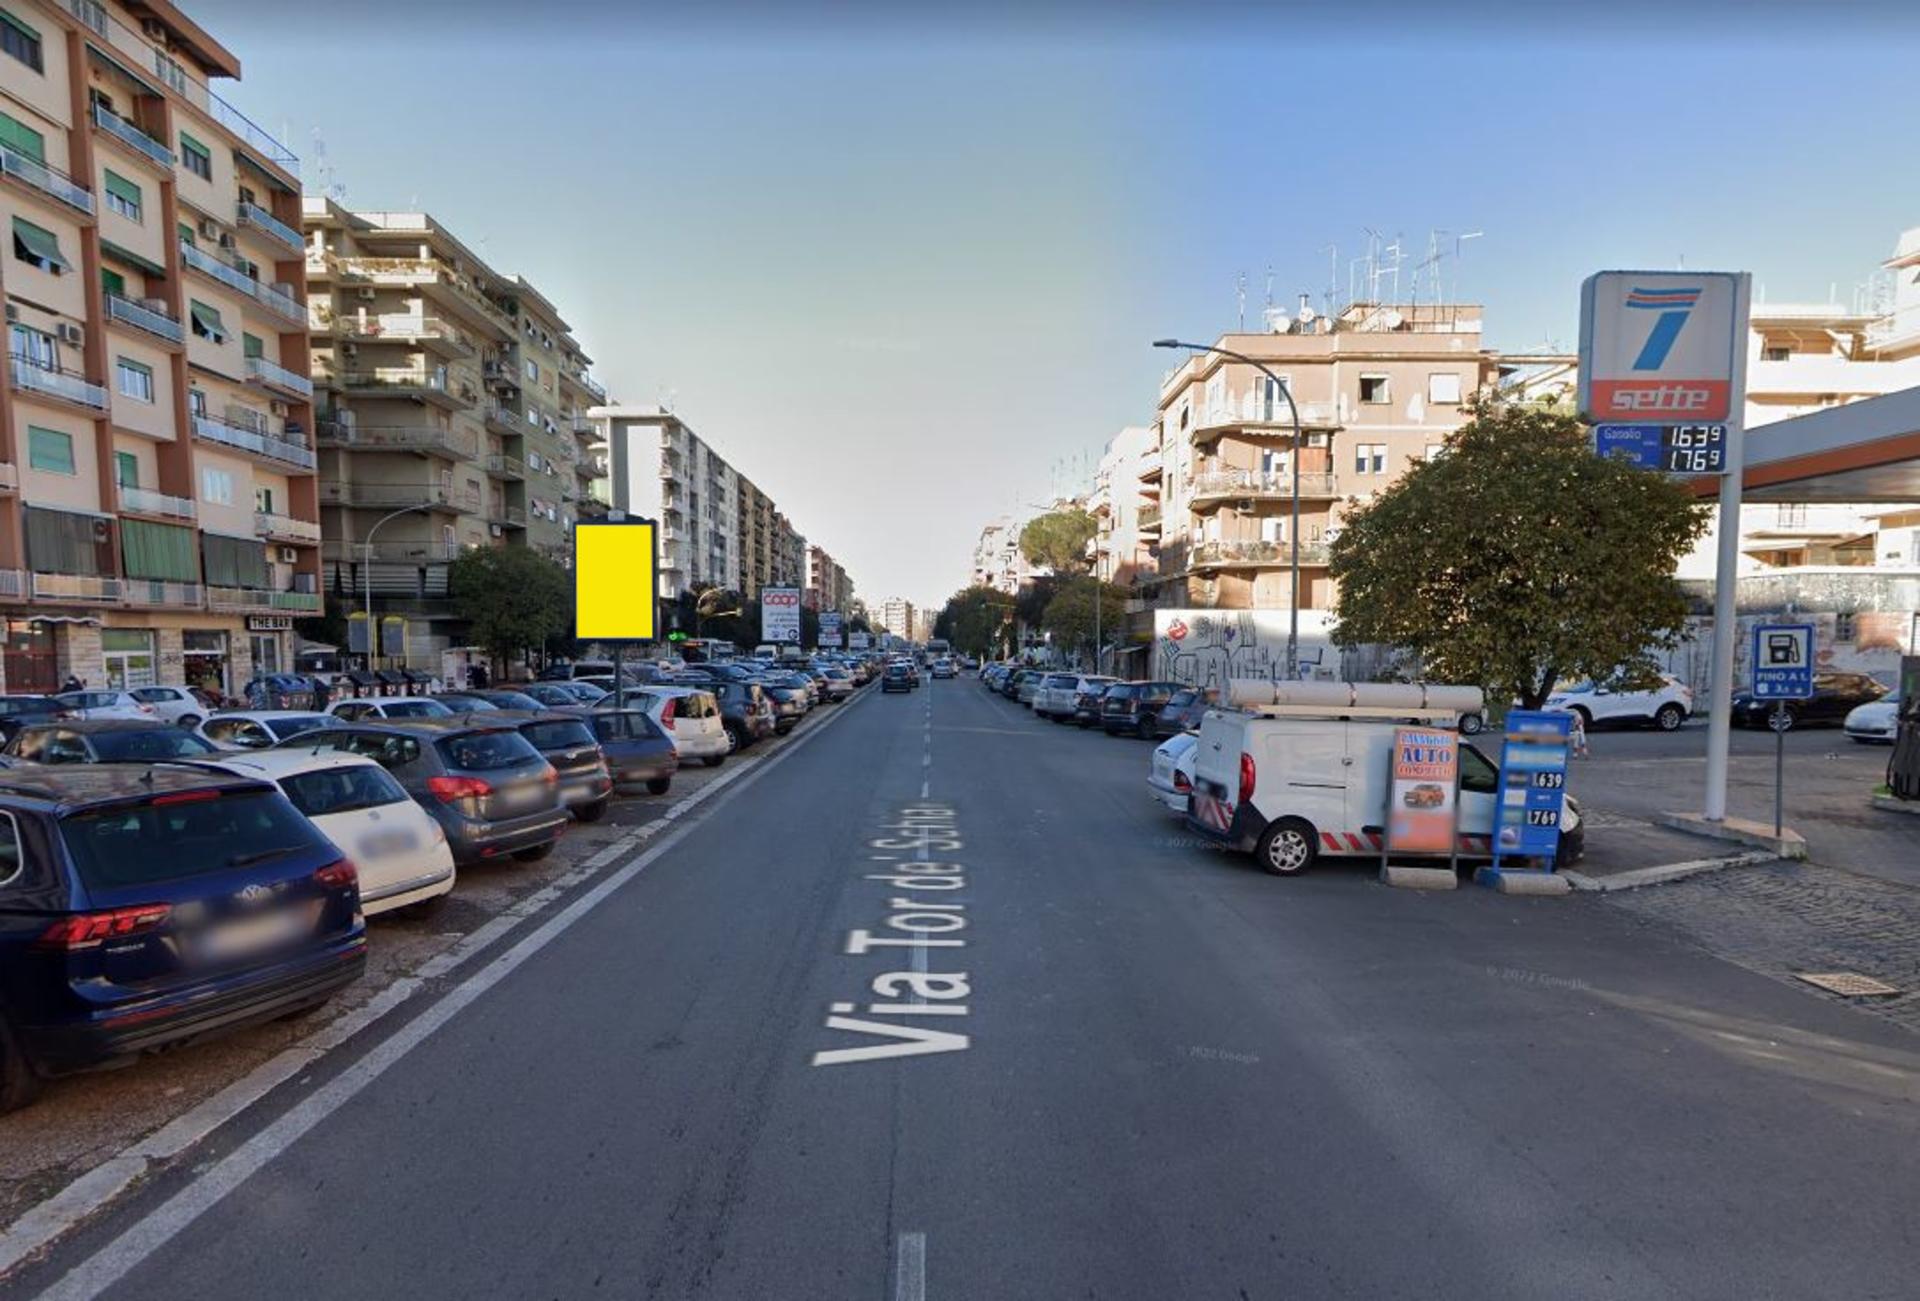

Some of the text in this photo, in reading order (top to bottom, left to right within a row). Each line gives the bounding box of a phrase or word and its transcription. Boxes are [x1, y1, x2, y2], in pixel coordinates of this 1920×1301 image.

[1611, 386, 1710, 410] sette
[764, 594, 799, 608] coop
[252, 617, 290, 628] THE BAR
[1757, 671, 1787, 682] FINO
[1788, 671, 1798, 682] A
[1401, 746, 1453, 764] AUTO
